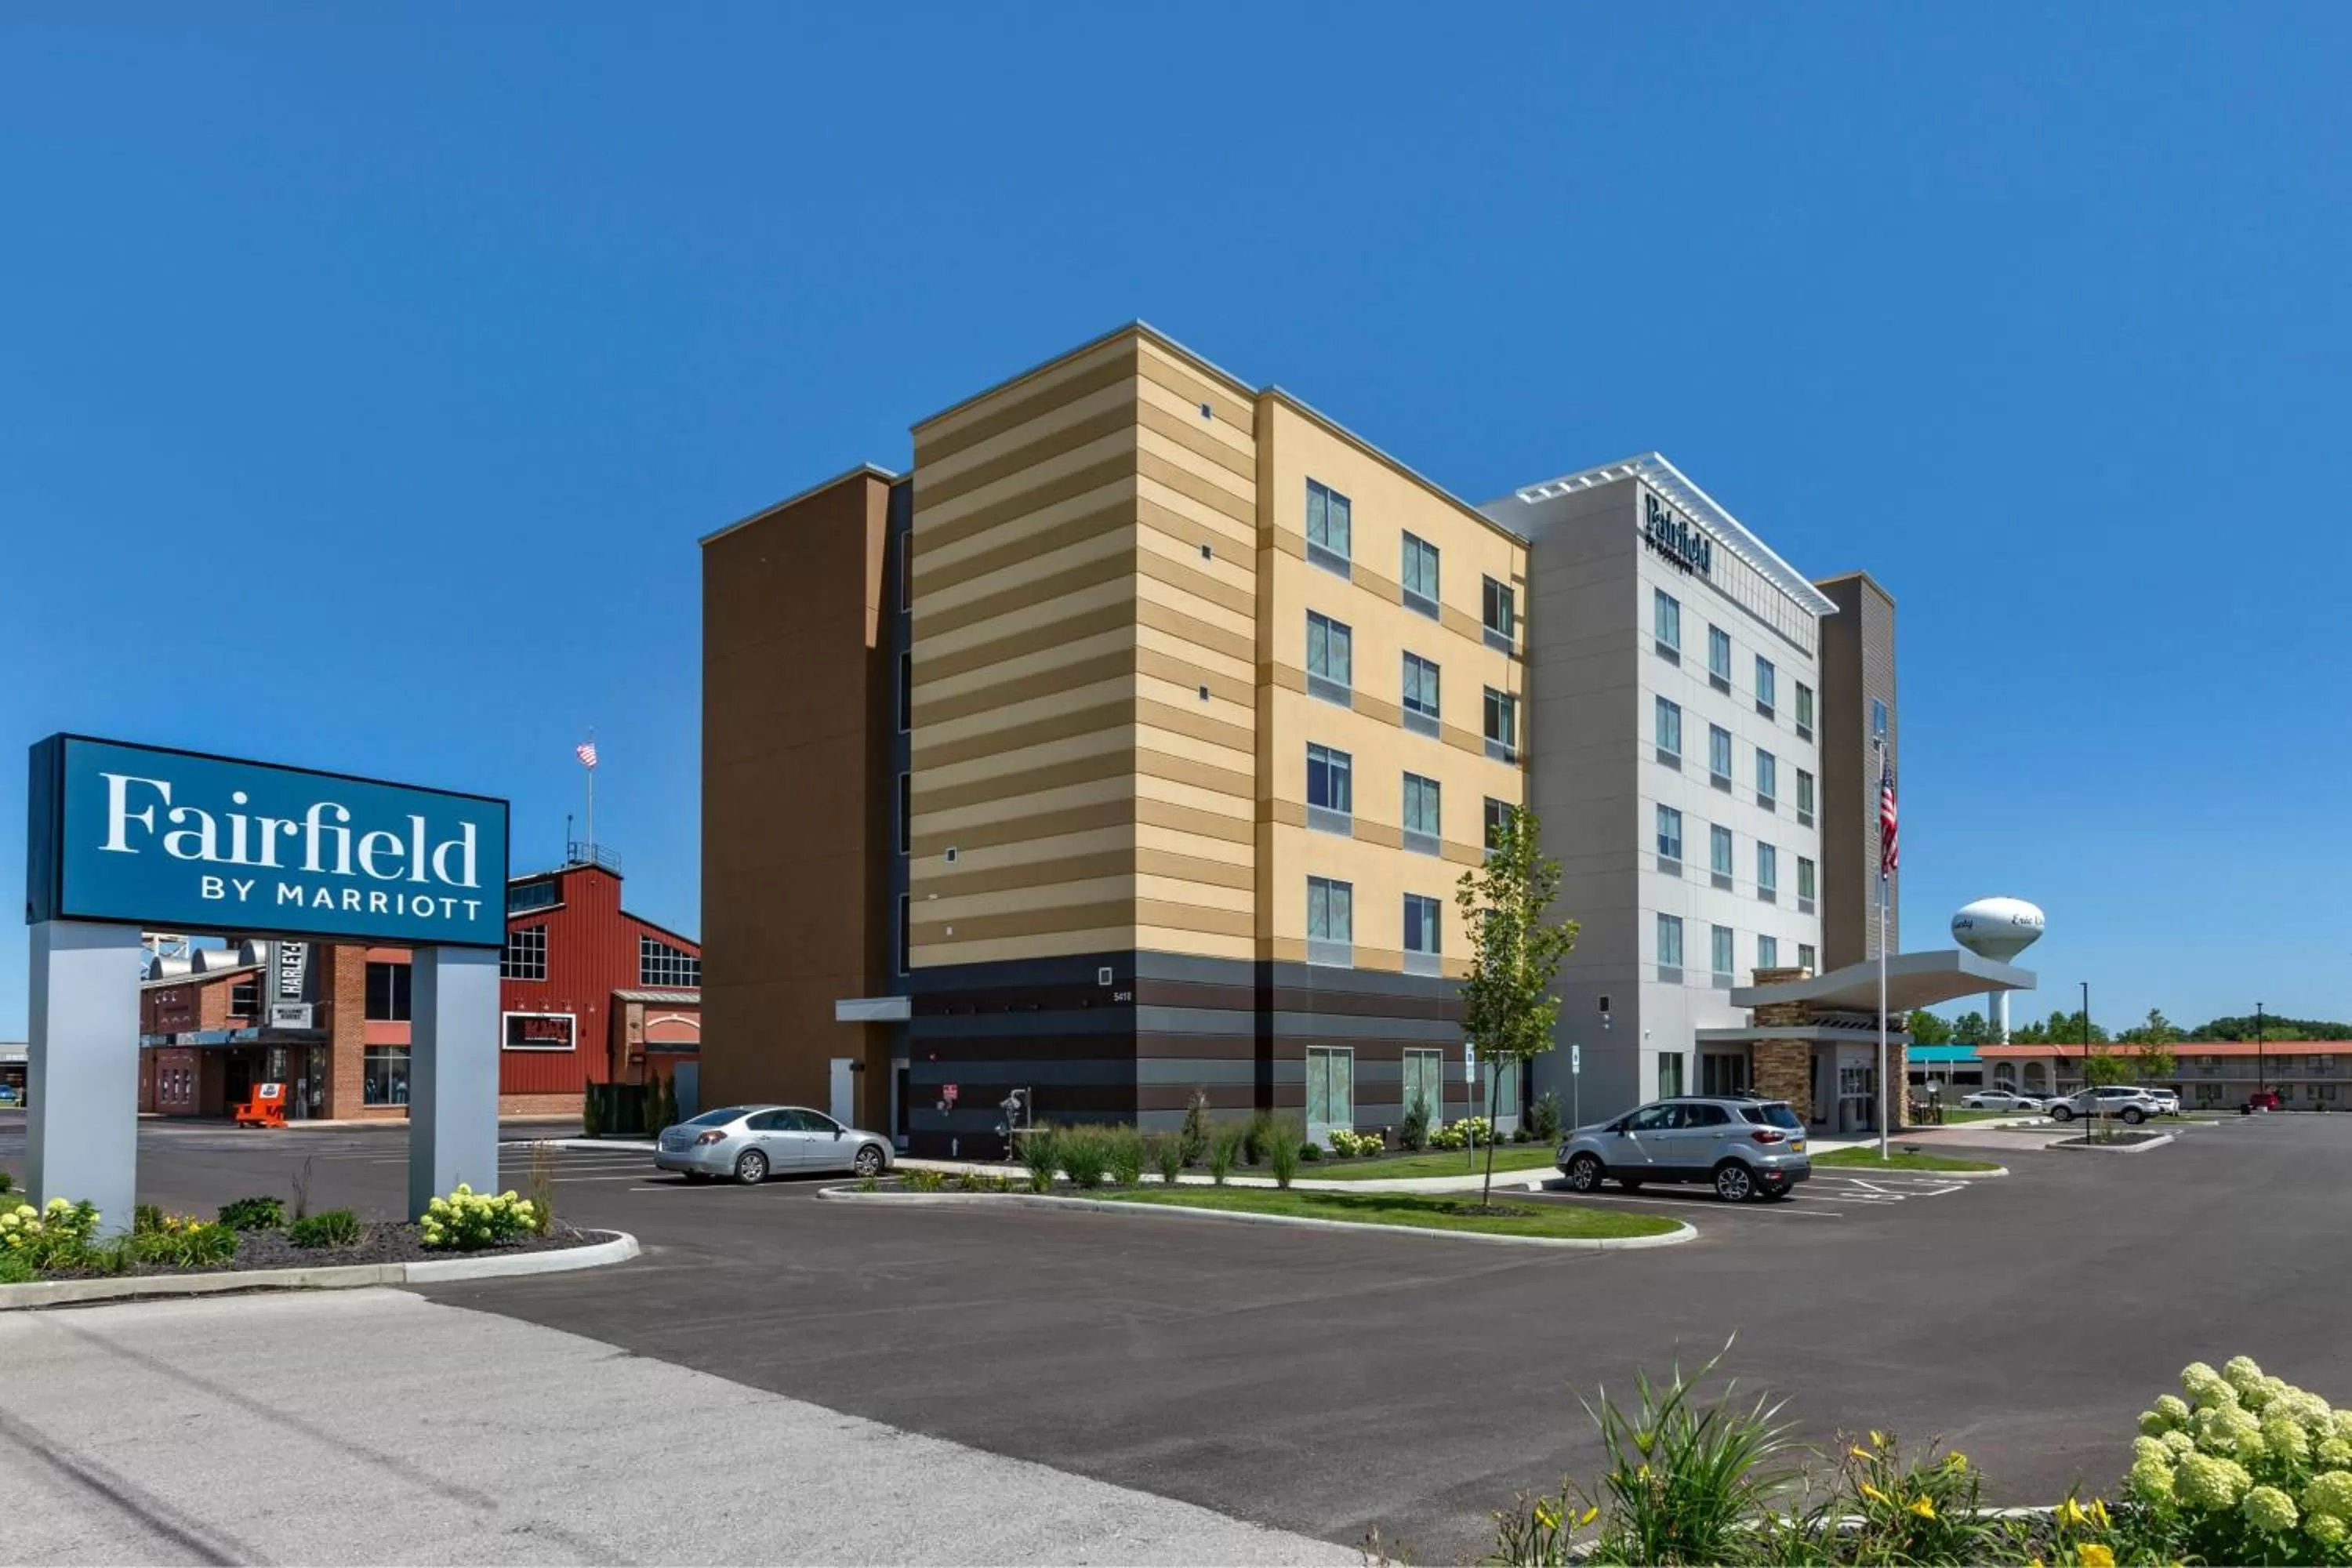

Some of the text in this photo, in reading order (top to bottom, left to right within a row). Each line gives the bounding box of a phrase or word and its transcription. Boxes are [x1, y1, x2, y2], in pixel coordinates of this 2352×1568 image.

[1645, 493, 1711, 574] Fairfield
[98, 771, 482, 889] Fairfield
[201, 875, 483, 921] BY MARRIOTT
